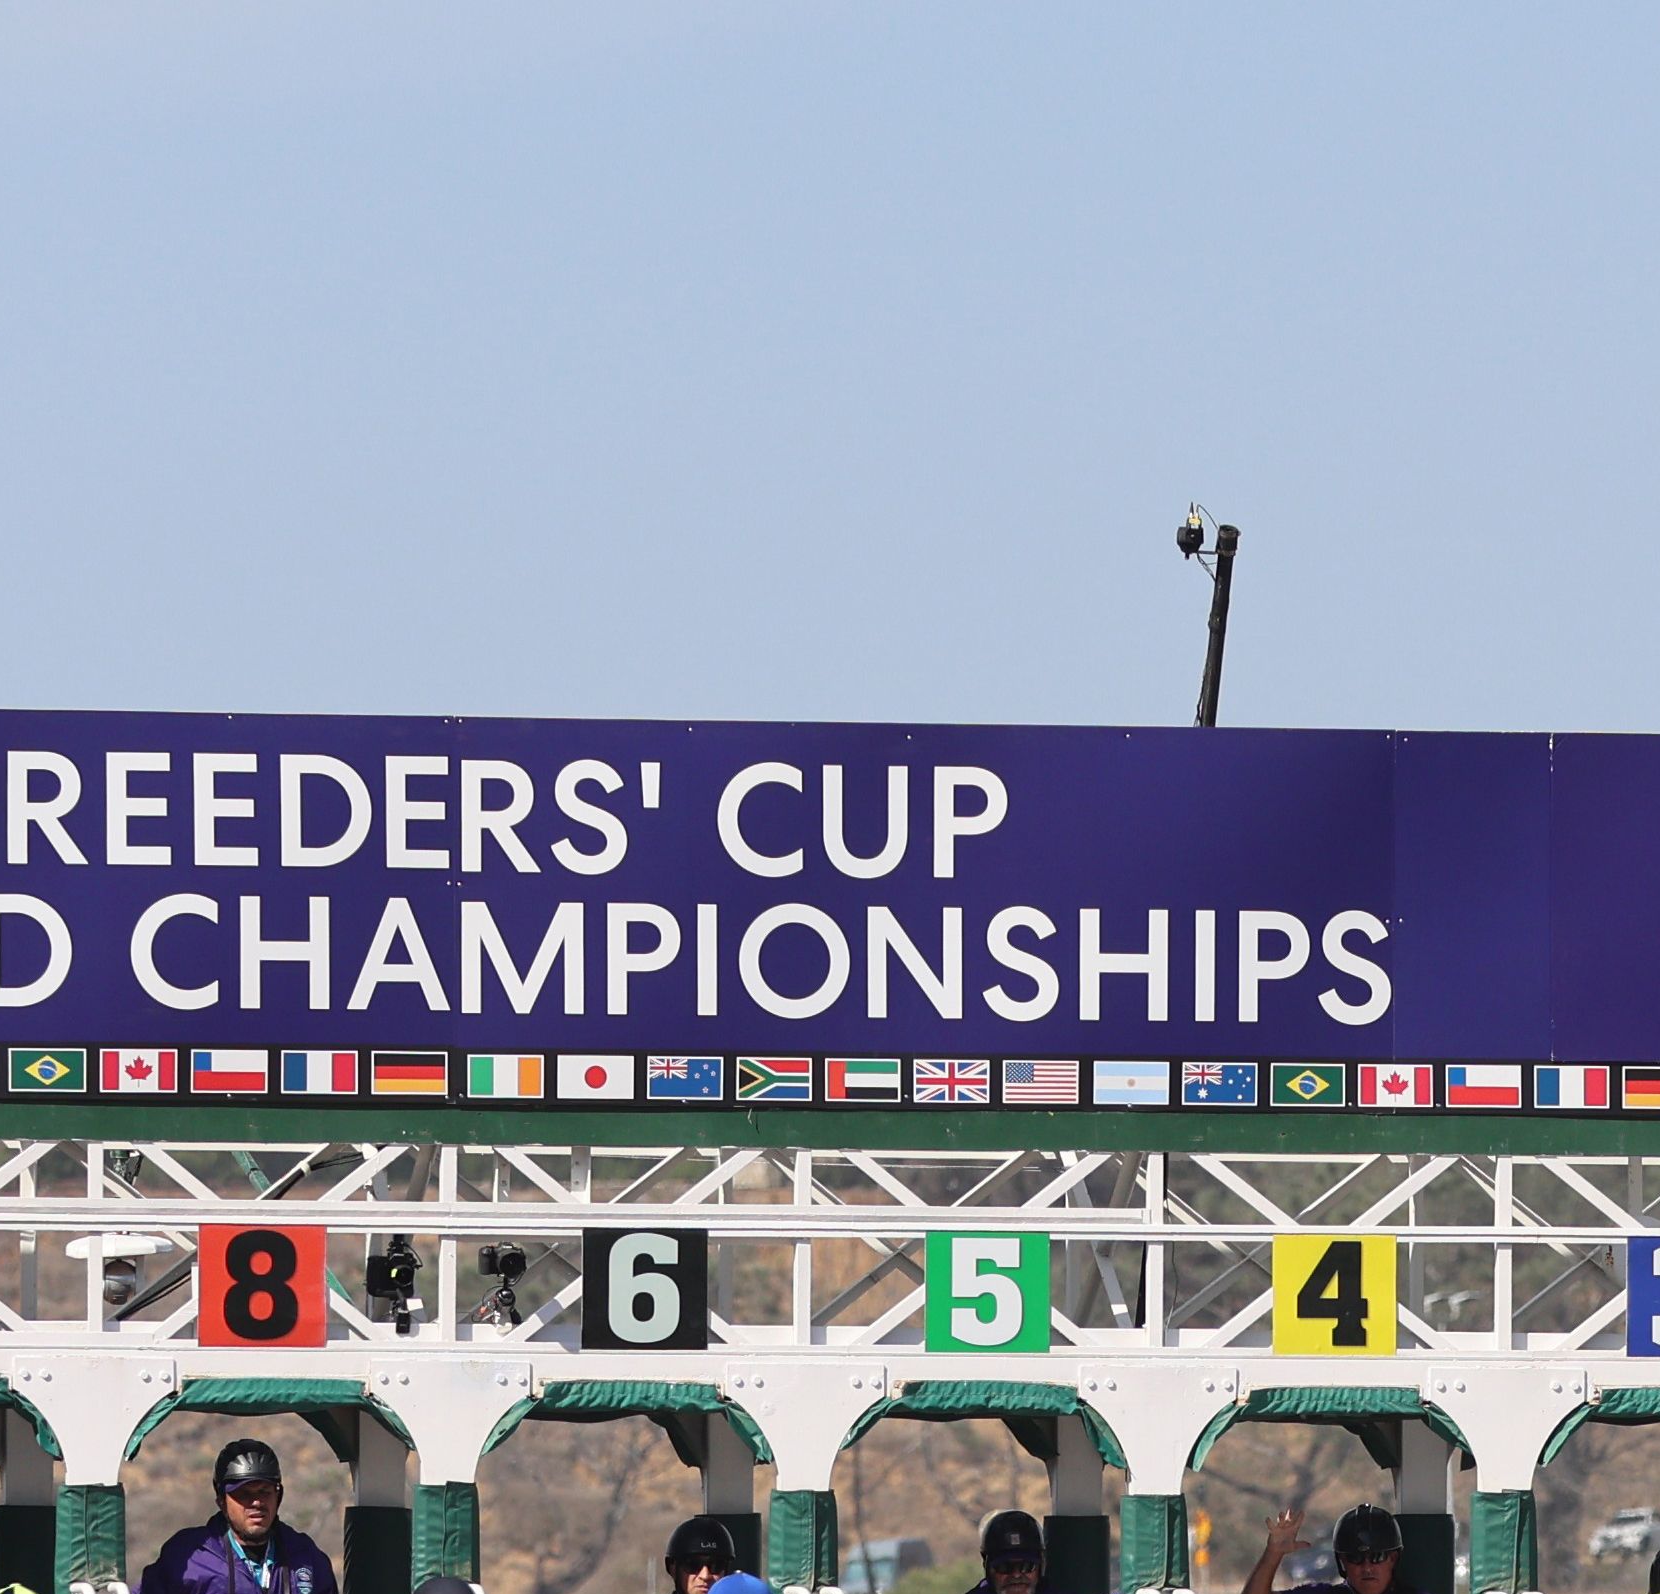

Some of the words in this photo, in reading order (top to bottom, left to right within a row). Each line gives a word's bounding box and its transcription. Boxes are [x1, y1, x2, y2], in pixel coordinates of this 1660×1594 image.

[717, 761, 1008, 879] CUP
[130, 893, 1392, 1026] CHAMPIONSHIPS
[224, 1229, 298, 1341] 8
[608, 1232, 680, 1343] 6
[951, 1237, 1023, 1346] 5
[1297, 1240, 1368, 1347] 4
